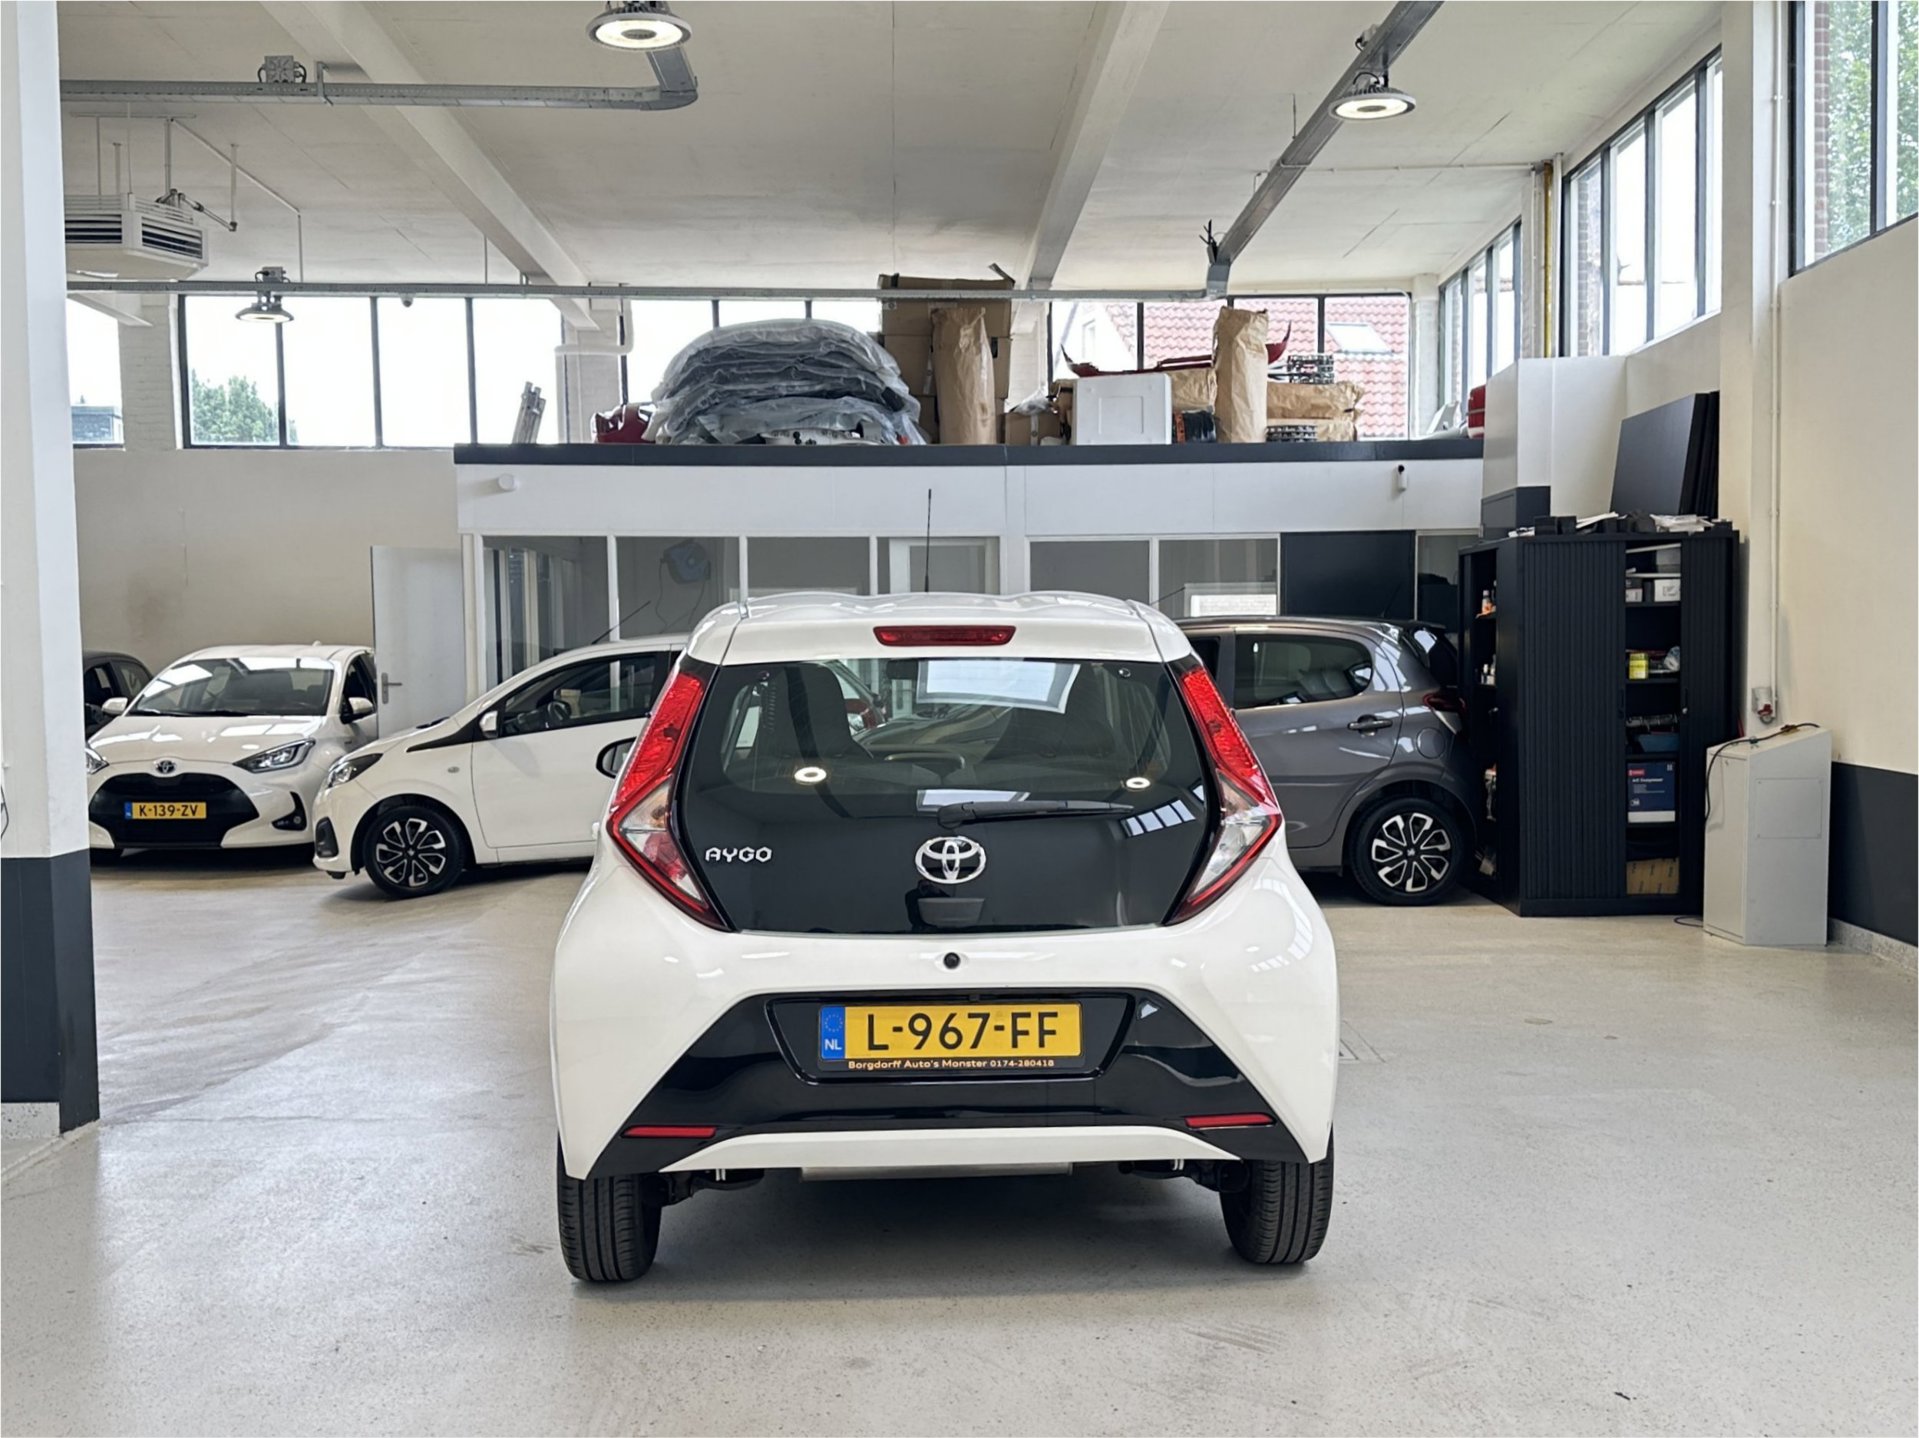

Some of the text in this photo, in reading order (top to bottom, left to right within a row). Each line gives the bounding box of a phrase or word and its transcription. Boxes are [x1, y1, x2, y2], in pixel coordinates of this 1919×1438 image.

[139, 805, 198, 816] K-139-ZV
[705, 847, 772, 862] AYGO
[867, 1012, 1059, 1051] L-967-FF
[824, 1039, 842, 1050] NL
[848, 1059, 1055, 1071] Borgdorff Auto's Monster 0174-280418
